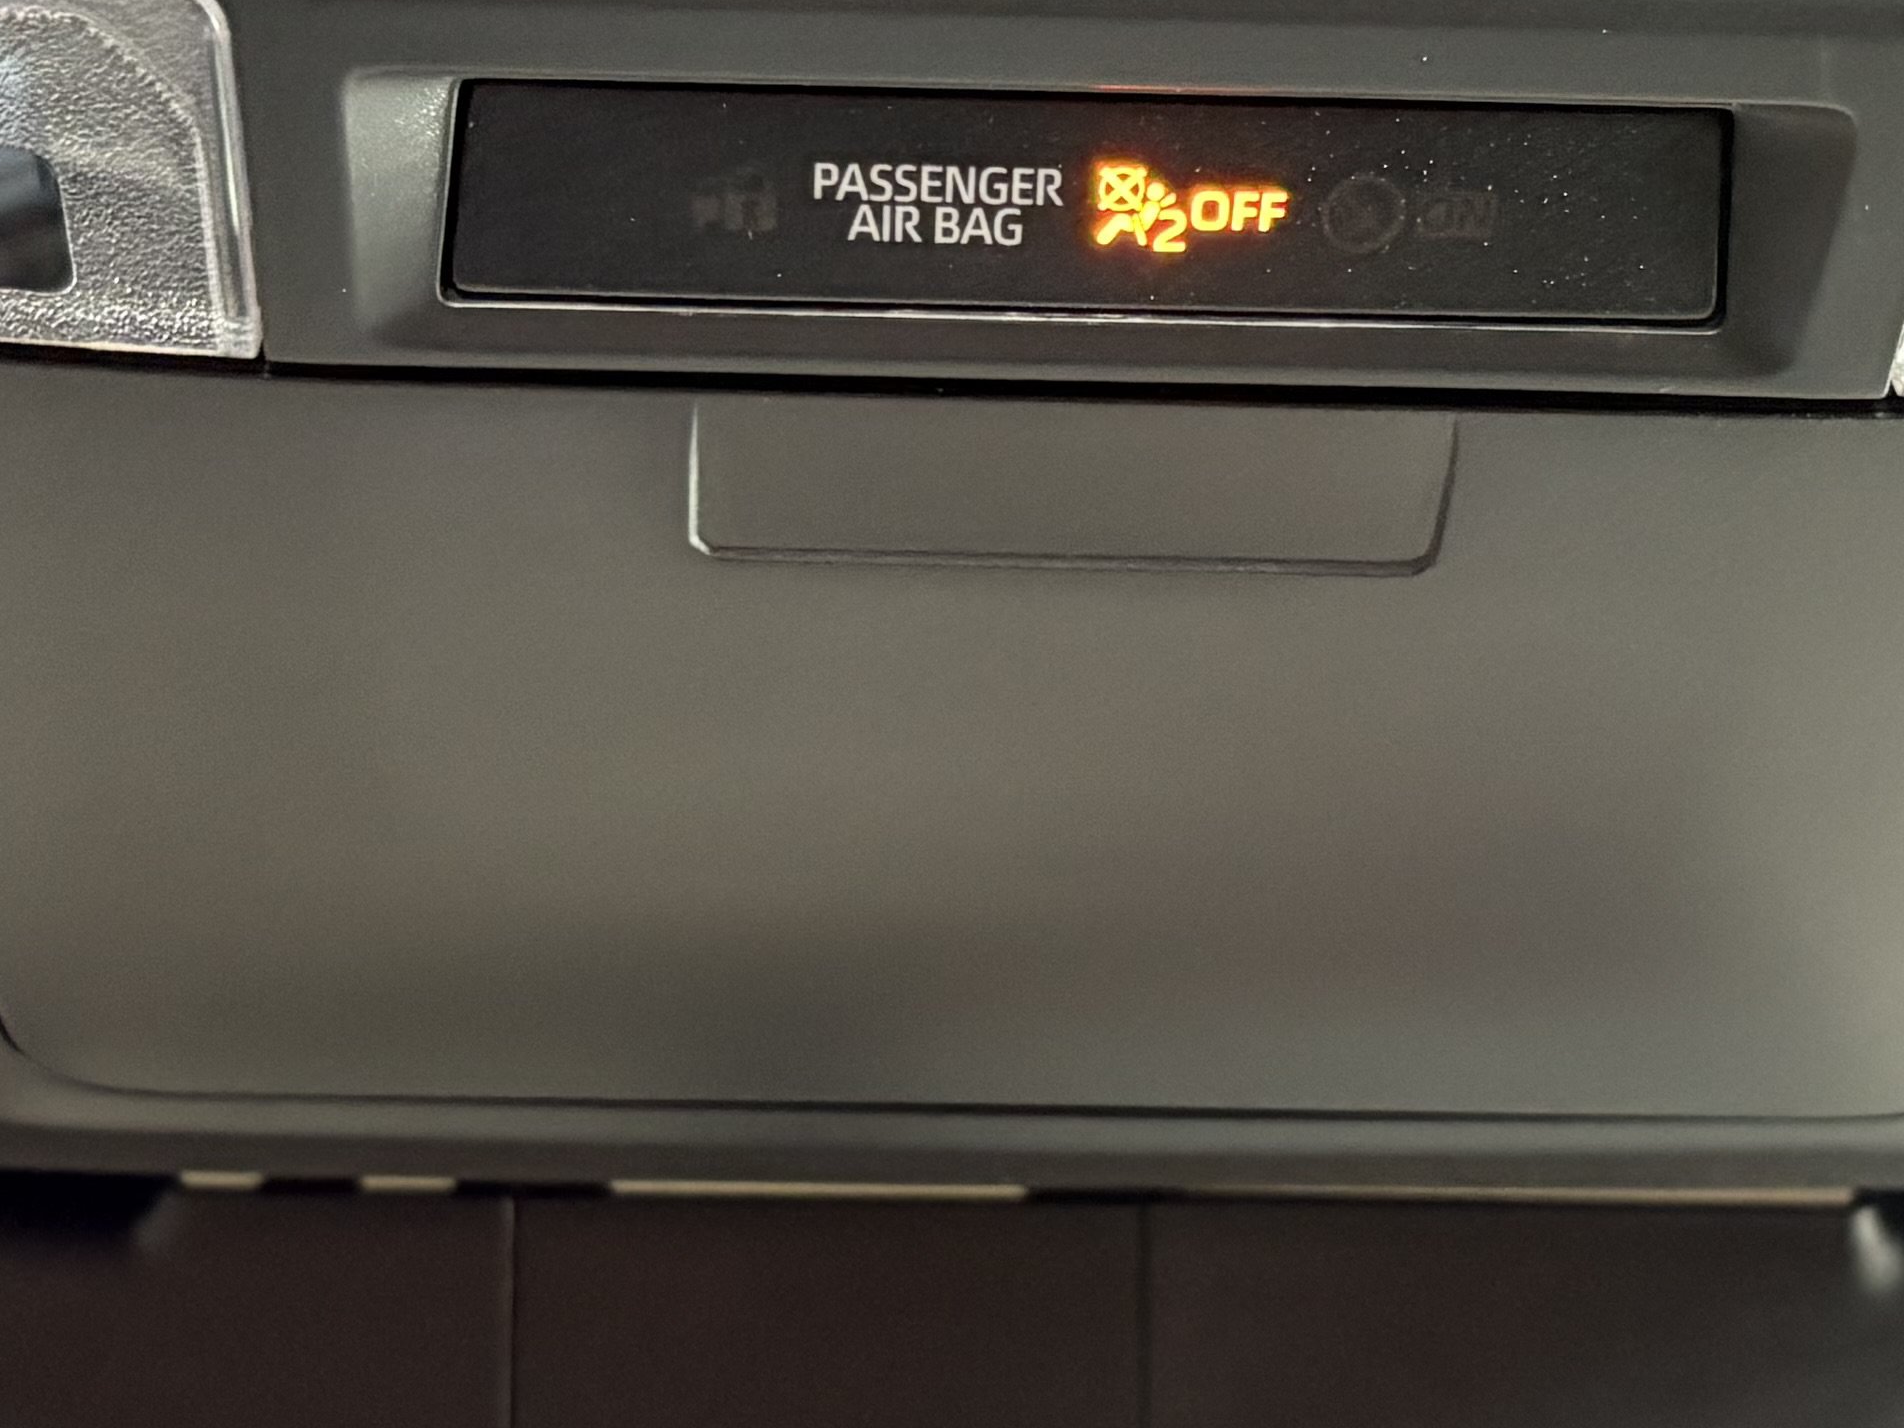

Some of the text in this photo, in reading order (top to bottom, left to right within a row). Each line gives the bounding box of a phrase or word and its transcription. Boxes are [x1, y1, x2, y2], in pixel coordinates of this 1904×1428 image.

[812, 162, 1065, 210] PASSENGER
[1190, 186, 1290, 234] OFF
[847, 206, 1026, 247] AIR BAG
